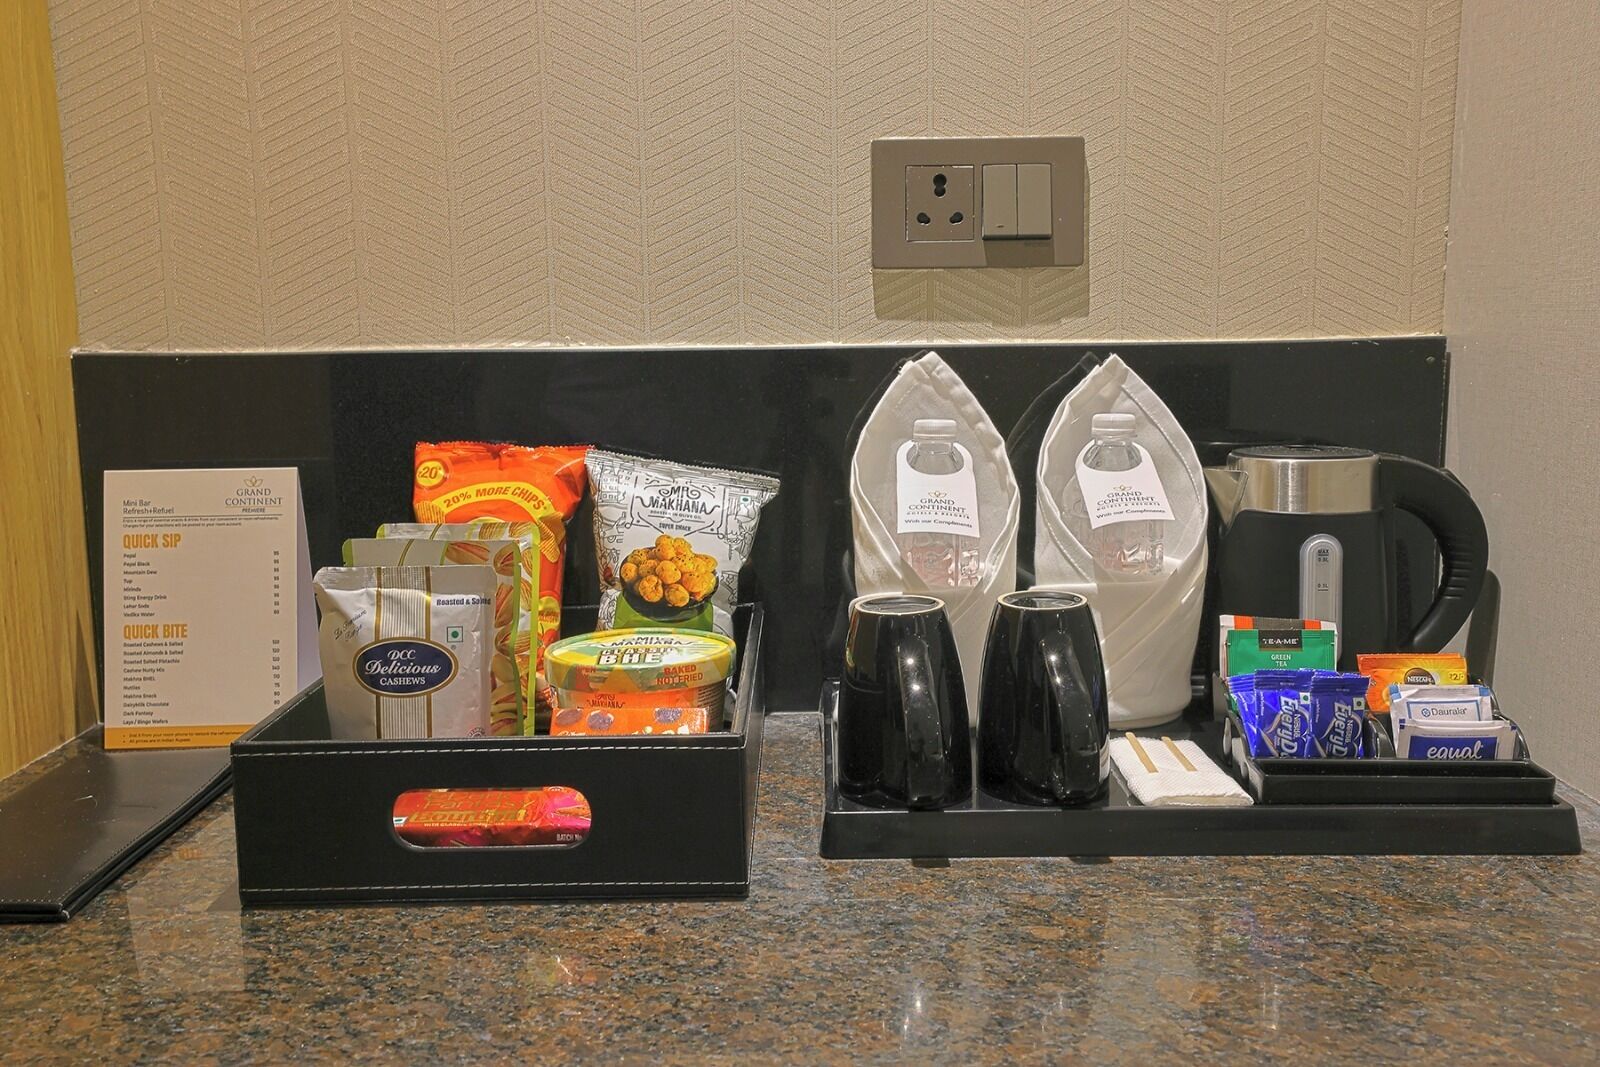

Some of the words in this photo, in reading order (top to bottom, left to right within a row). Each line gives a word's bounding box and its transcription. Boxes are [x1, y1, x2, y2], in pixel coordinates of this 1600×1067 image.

[236, 488, 271, 496] GRAND
[443, 491, 472, 508] 20%
[475, 486, 511, 498] MORE
[658, 485, 701, 500] MR
[225, 497, 283, 506] CONTINENT
[636, 496, 719, 514] MAKHANA
[1096, 496, 1155, 506] CONTINENT
[908, 504, 966, 513] CONTINENT
[123, 534, 159, 549] QUICK
[436, 598, 464, 606] Roasted
[124, 624, 159, 640] QUICK
[163, 624, 188, 638] BITE
[387, 649, 416, 660] DCC
[598, 653, 672, 665] BHE
[364, 659, 442, 676] Delicious
[663, 665, 697, 675] BAKED
[379, 677, 426, 686] CASHEWS
[656, 677, 676, 686] NOT
[678, 672, 703, 682] FRIED
[1431, 708, 1465, 716] Daurala
